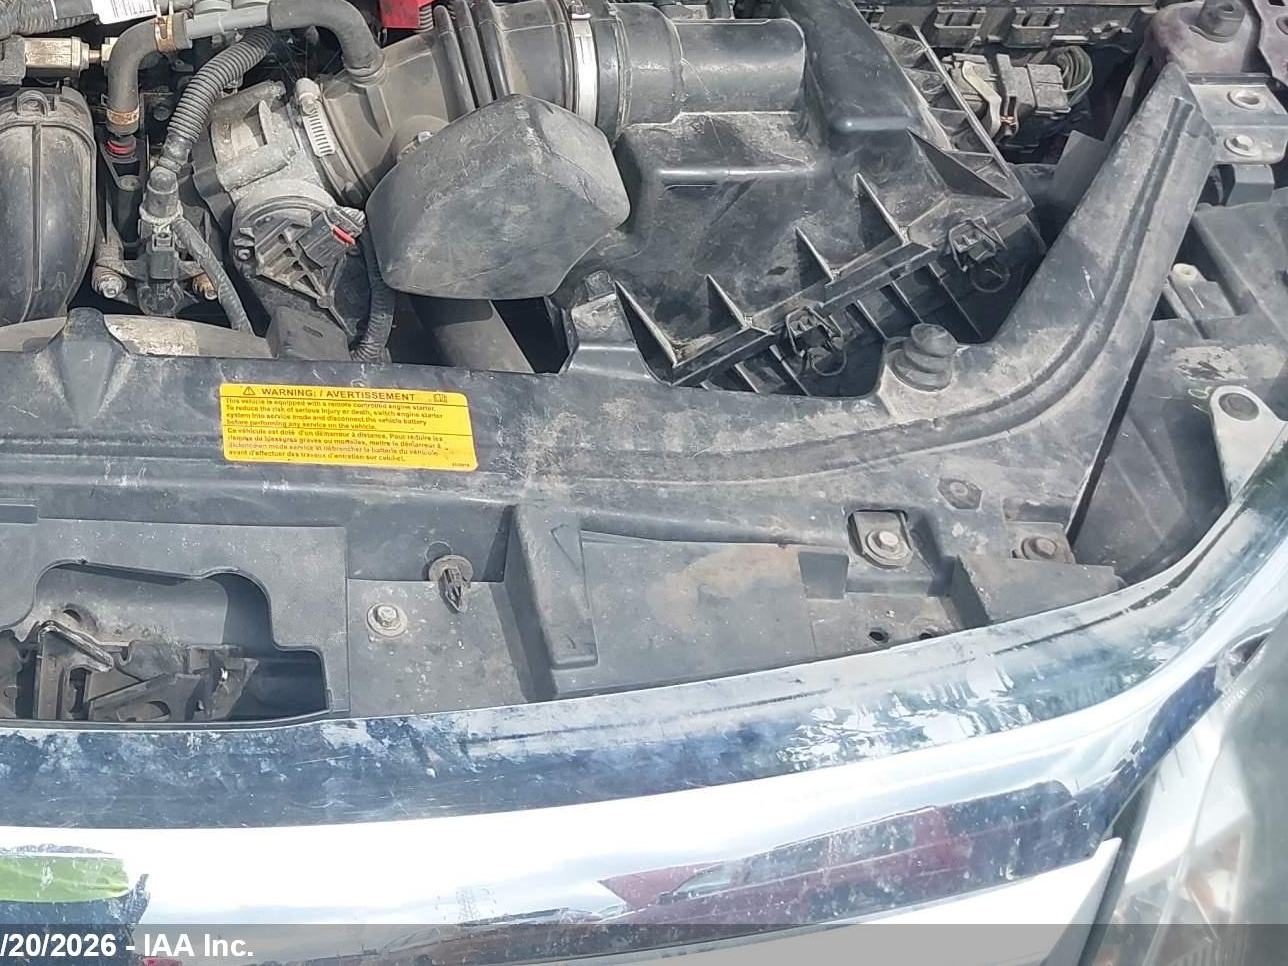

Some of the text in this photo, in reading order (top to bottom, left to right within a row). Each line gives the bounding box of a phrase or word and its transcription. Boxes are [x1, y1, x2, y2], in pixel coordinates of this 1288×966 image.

[261, 388, 317, 397] WARNING:
[326, 389, 416, 401] AVERTISSEMENT
[274, 400, 305, 408] equipped
[321, 408, 340, 416] injury
[249, 420, 286, 428] performing
